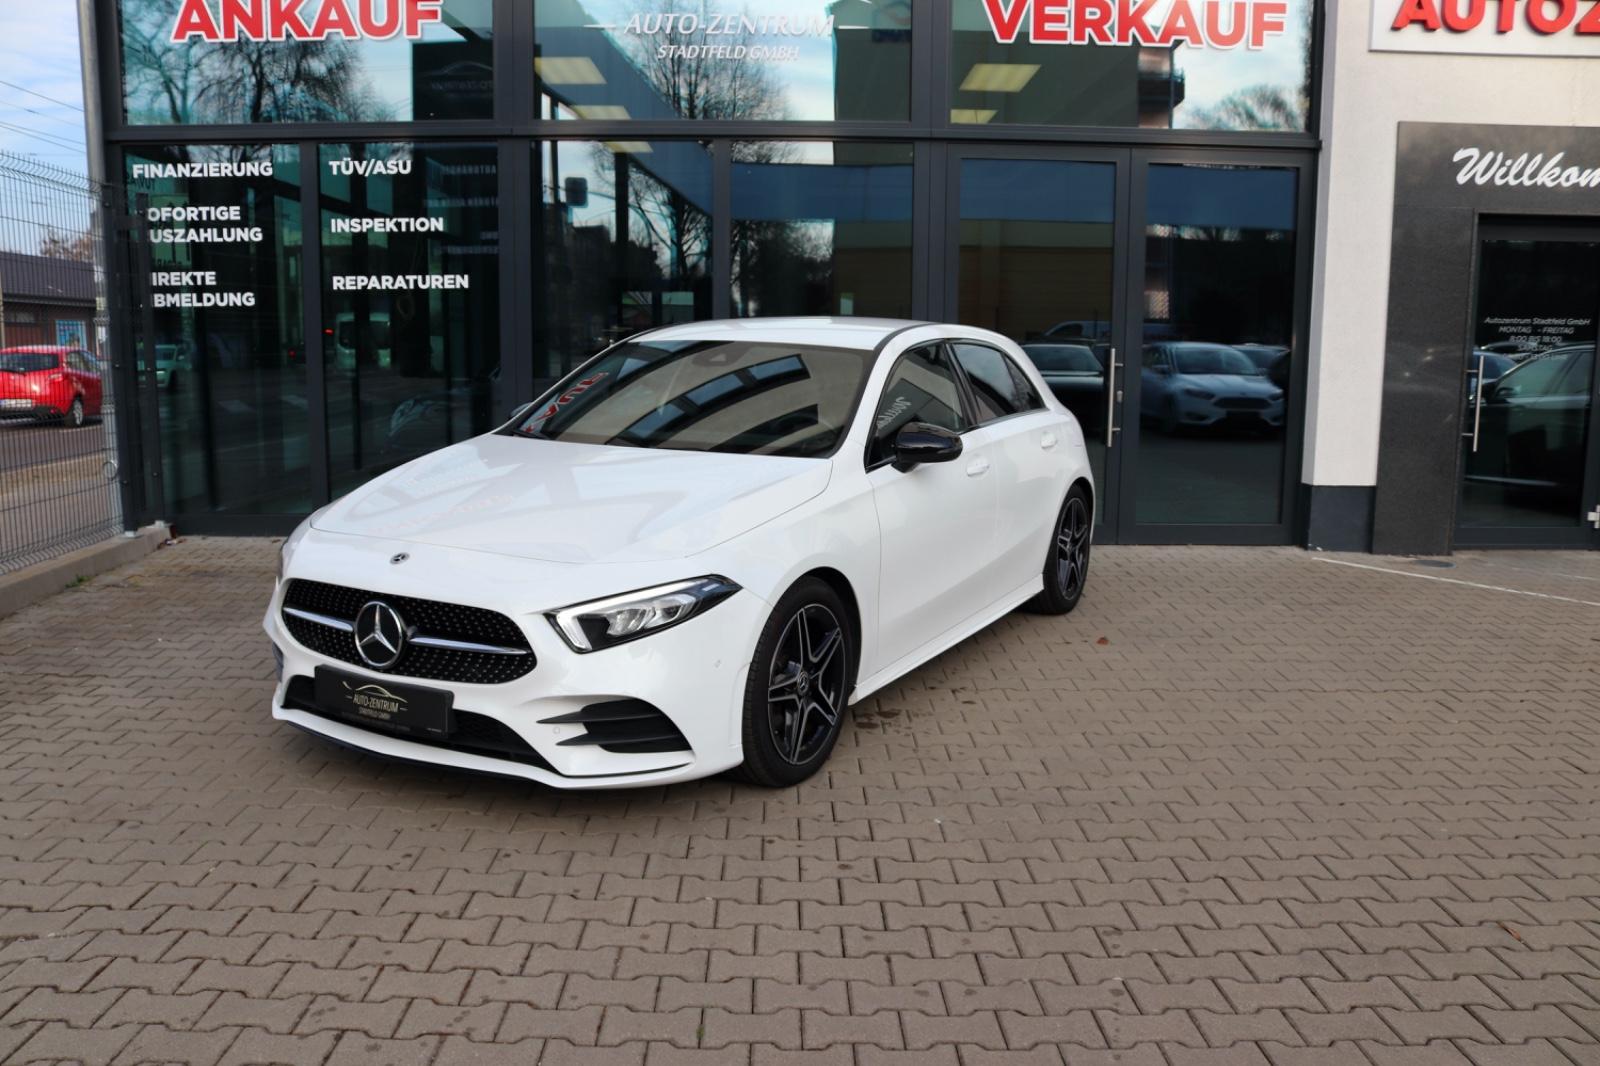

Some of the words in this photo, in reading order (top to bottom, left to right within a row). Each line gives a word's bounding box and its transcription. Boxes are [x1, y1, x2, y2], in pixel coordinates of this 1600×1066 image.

[169, 0, 442, 42] ANKAUF
[623, 13, 835, 37] AUTO-ZENTRUM
[983, 0, 1288, 49] VERKAUF
[657, 45, 746, 60] STADTFELD
[750, 46, 801, 60] GMBH
[132, 162, 273, 178] FINANZIERUNG
[328, 157, 412, 177] TÜV/ASU
[147, 206, 241, 222] OFORTIGE
[331, 217, 444, 233] INSPEKTION
[149, 227, 263, 243] USZAHLUNG
[151, 271, 217, 286] IREKTE
[332, 274, 469, 290] REPARATUREN
[153, 292, 256, 308] BMELDUNG
[1542, 326, 1575, 334] FREITAG
